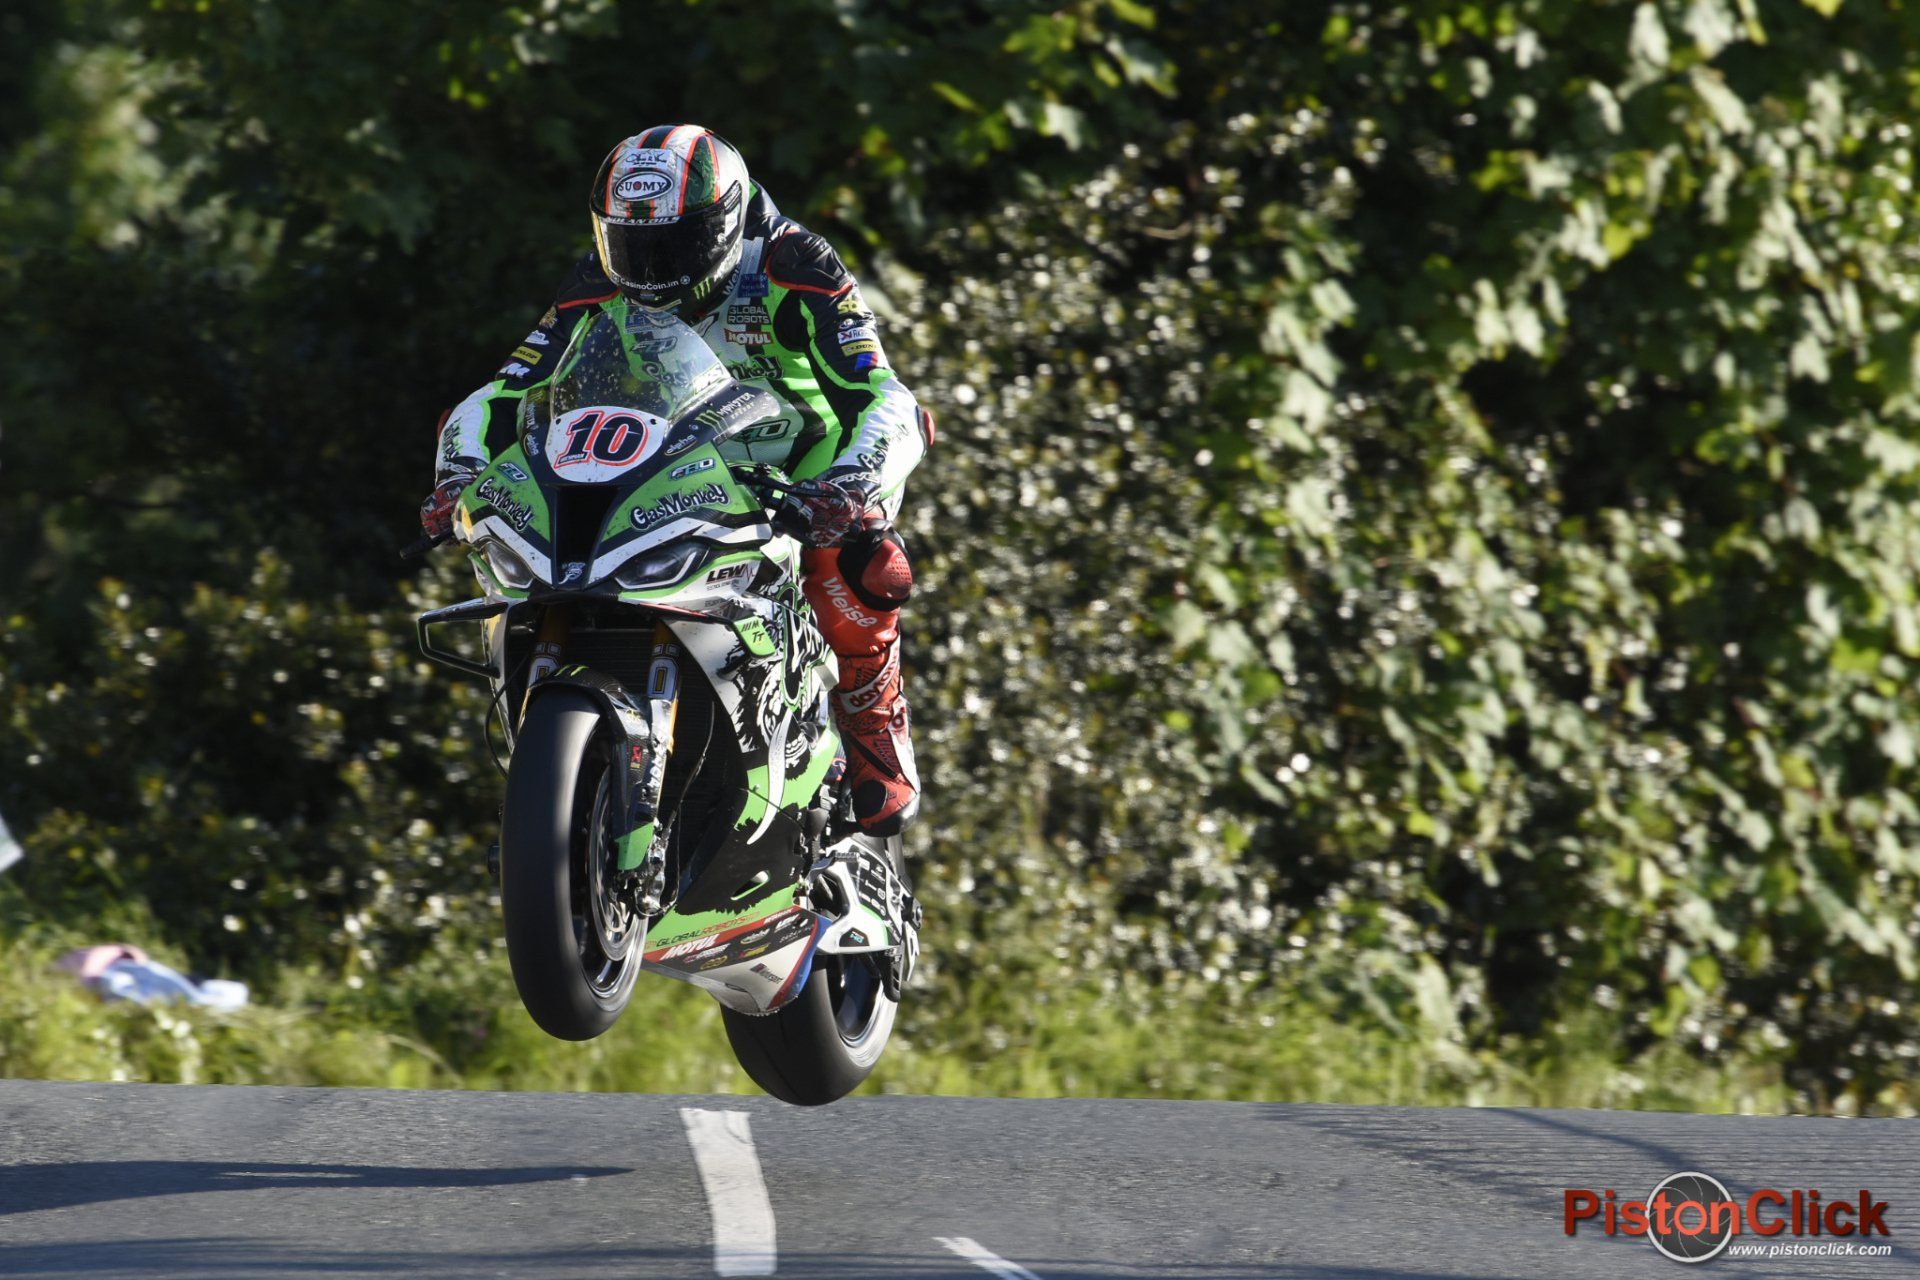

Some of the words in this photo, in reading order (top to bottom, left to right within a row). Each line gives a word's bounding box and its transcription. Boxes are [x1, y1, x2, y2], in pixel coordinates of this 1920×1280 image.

[618, 181, 666, 192] SUOMY
[728, 315, 770, 324] ROBOTS
[730, 306, 767, 315] GLOBAL
[728, 333, 772, 345] MOTUL
[554, 410, 649, 469] 10
[629, 483, 732, 531] GasMonkey
[706, 563, 748, 583] LEW
[823, 576, 879, 628] Weise
[659, 933, 721, 961] MOTUL
